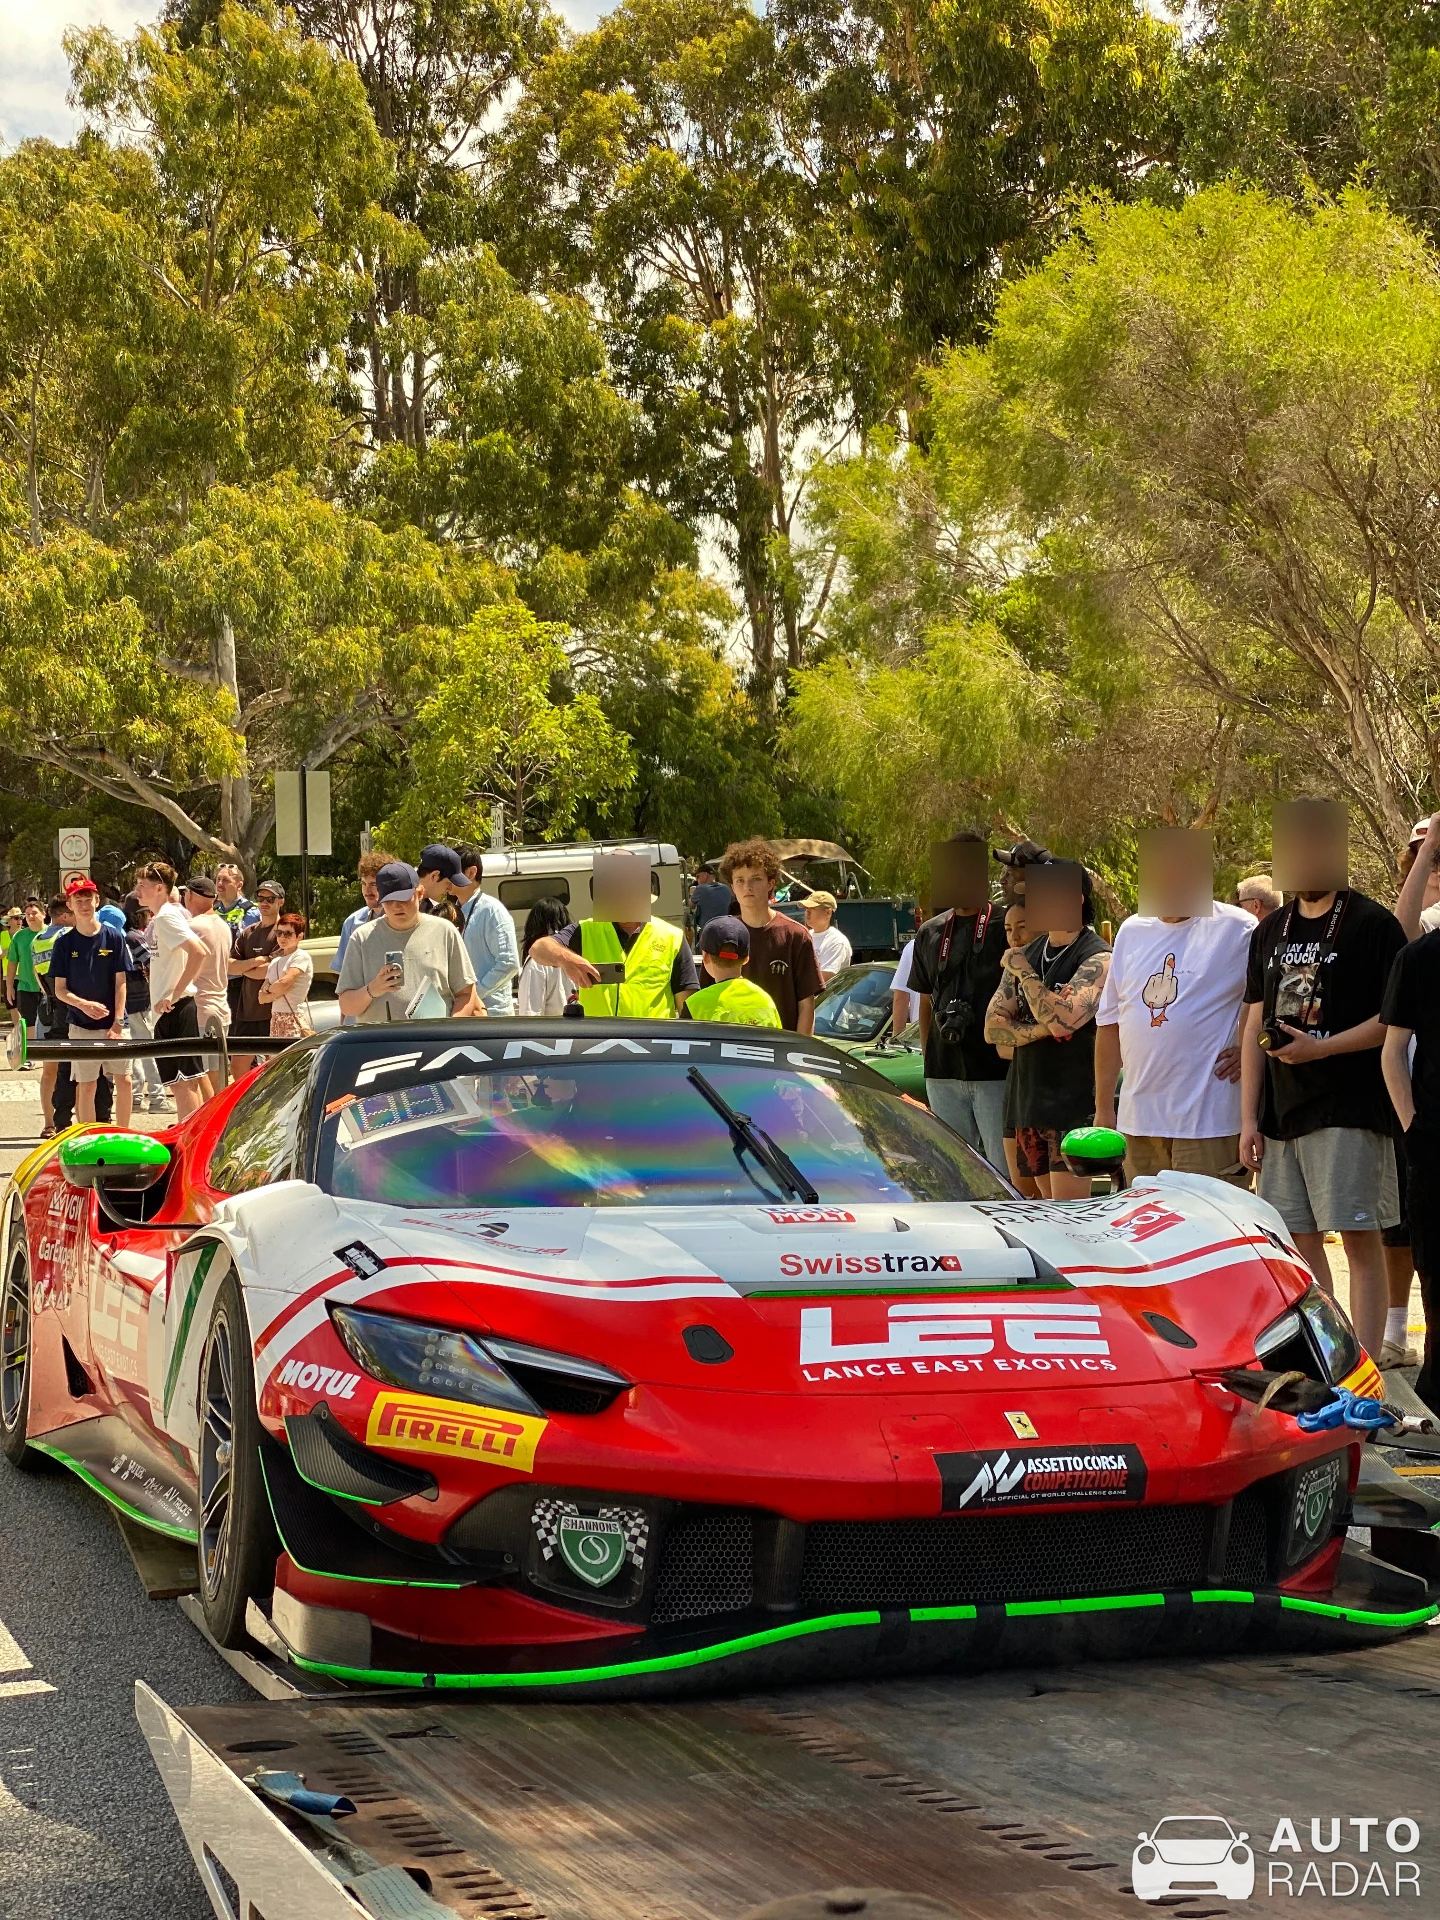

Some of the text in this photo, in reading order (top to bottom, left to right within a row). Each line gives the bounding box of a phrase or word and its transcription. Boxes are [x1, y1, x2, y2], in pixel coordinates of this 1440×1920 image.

[355, 1039, 842, 1087] FANATEC
[772, 1211, 850, 1222] MOLY
[779, 1252, 949, 1276] Swisstrax
[799, 1302, 1110, 1365] LEE
[276, 1359, 361, 1399] MOTUL
[802, 1358, 1118, 1382] LANCE EAST EXOTICS
[377, 1402, 525, 1457] PIRELLI
[1027, 1455, 1127, 1474] ASSETTO CORSA
[1023, 1470, 1129, 1492] COMPETIZIONE
[998, 1493, 1029, 1501] OFFICIAL
[563, 1518, 620, 1533] SHANNONS
